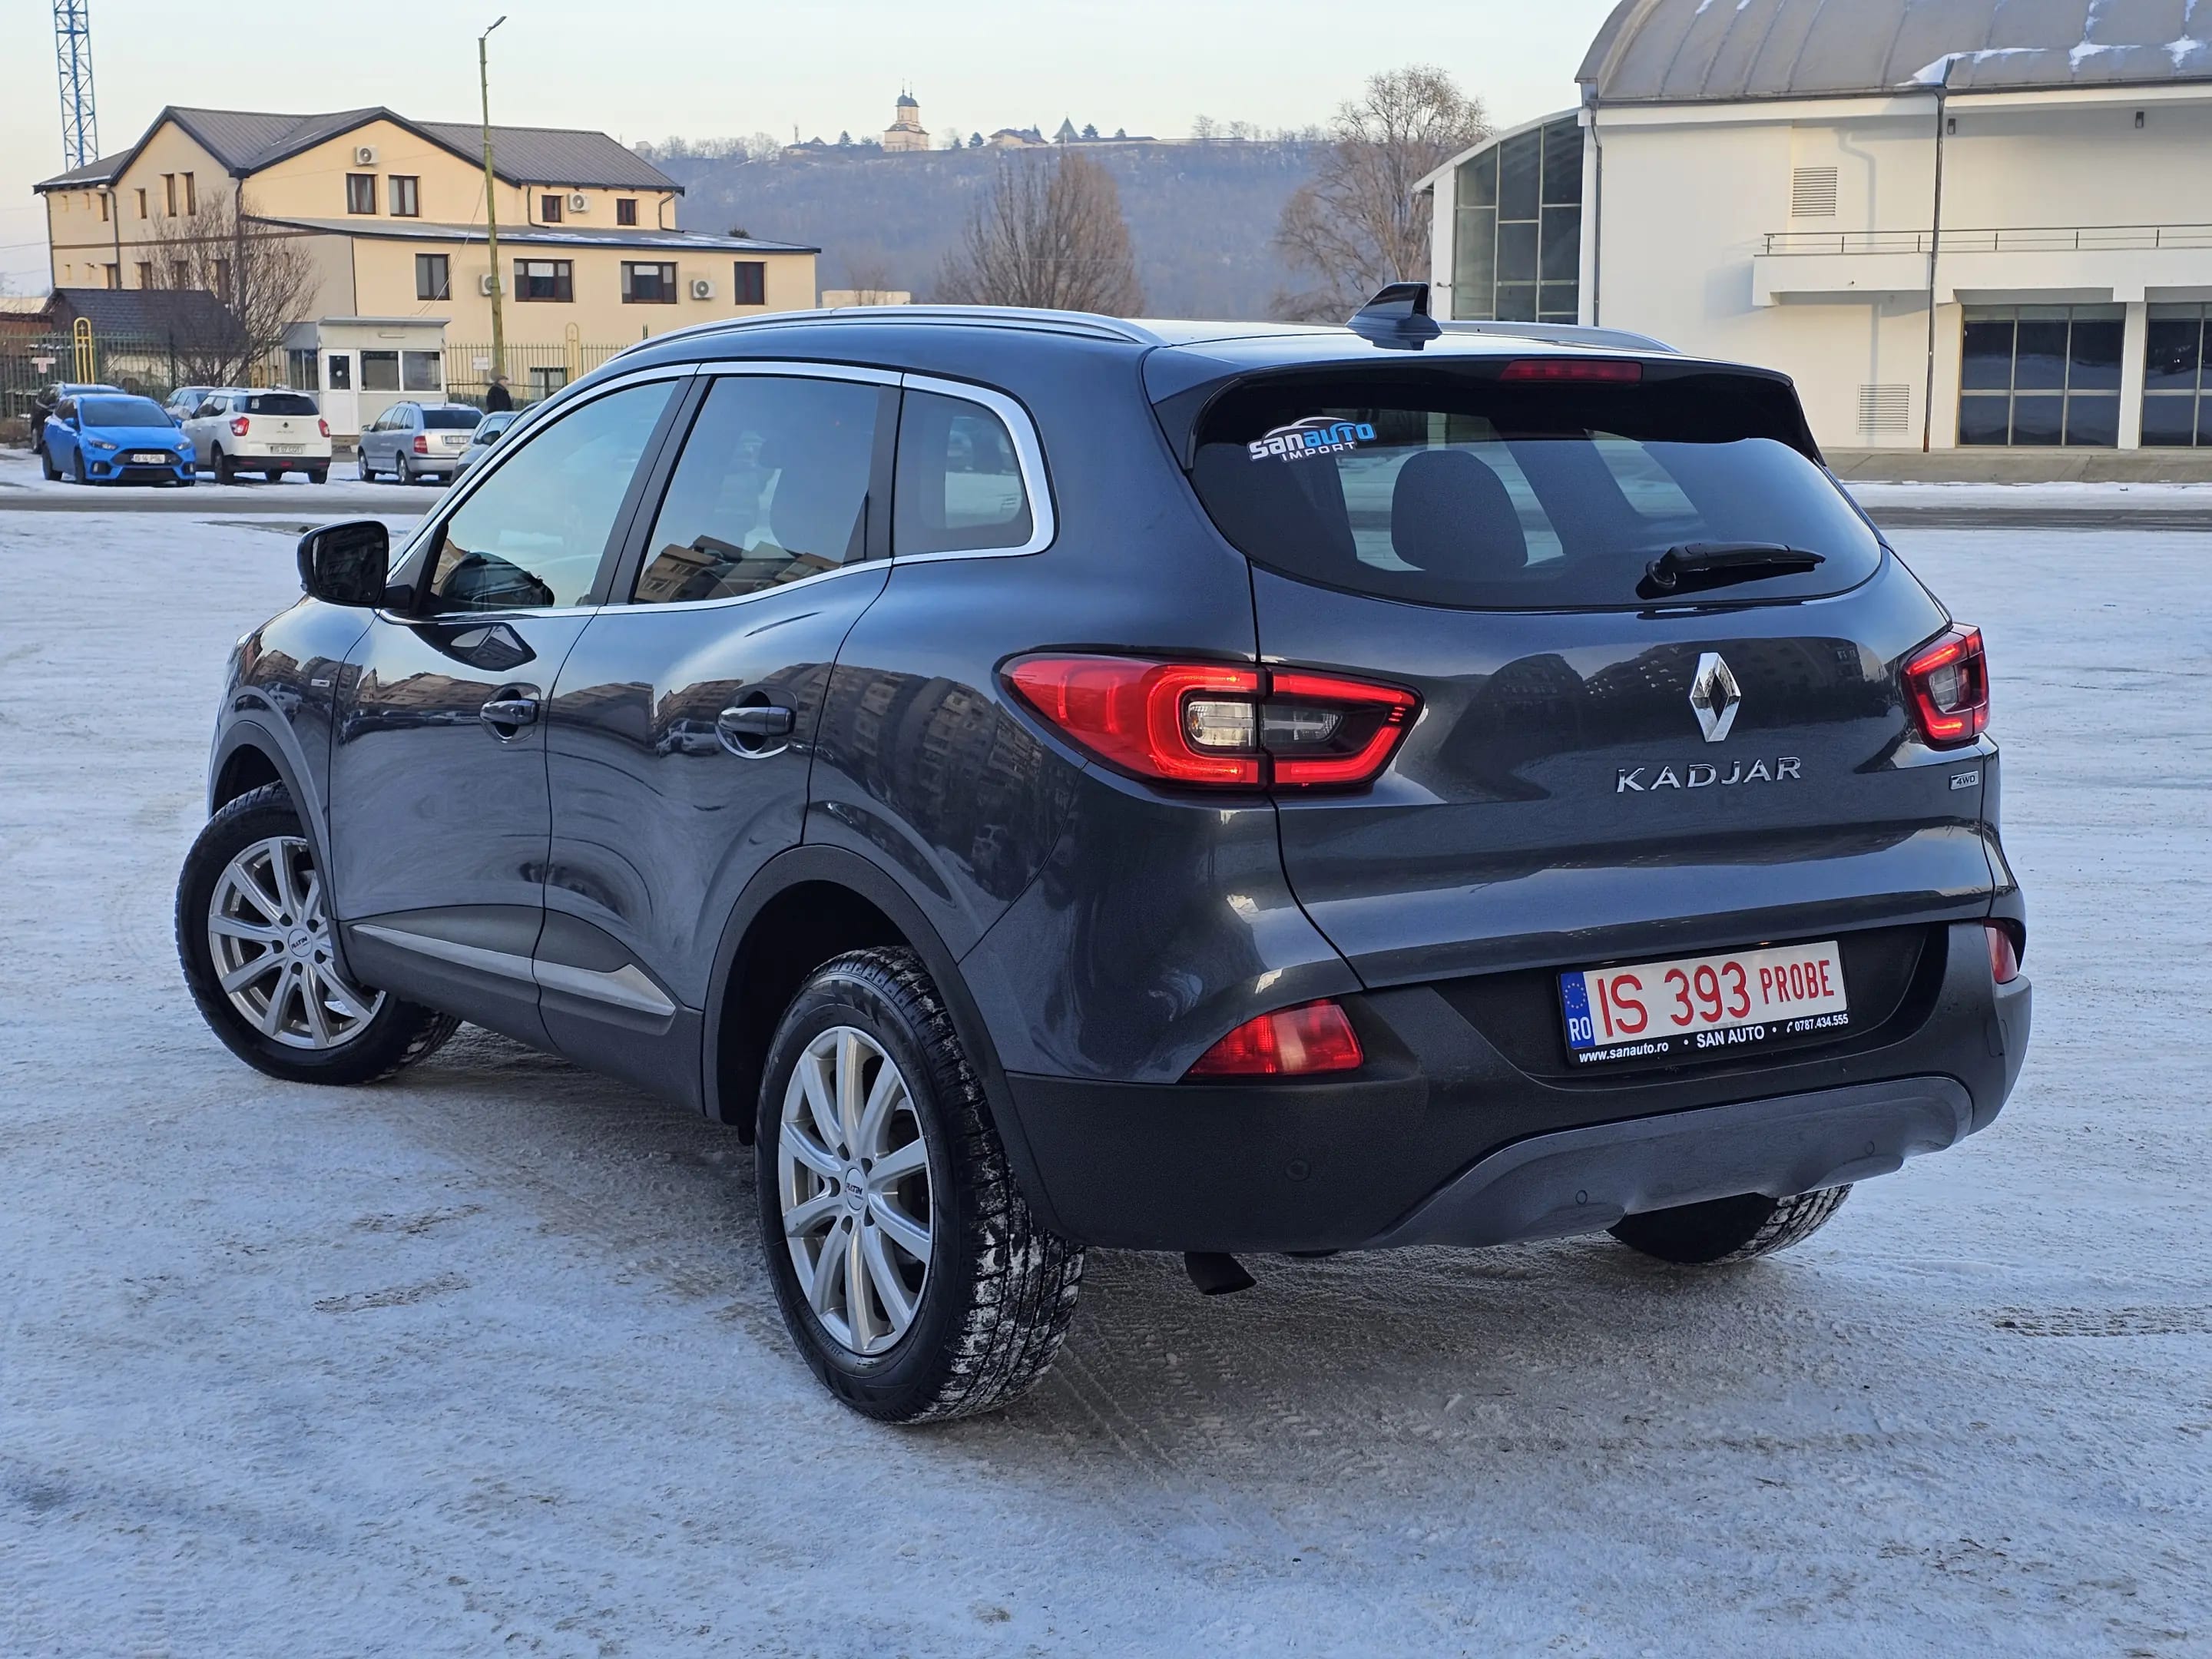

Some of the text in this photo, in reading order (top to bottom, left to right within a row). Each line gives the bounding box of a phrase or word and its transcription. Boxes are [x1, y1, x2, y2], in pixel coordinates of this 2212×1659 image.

[1282, 442, 1355, 461] IMPORT
[1616, 757, 1801, 793] KADJAR
[1956, 775, 1975, 785] 4WD
[1597, 959, 1835, 1038] IS 393 PROBE
[1568, 1015, 1591, 1042] RO
[1579, 1013, 1849, 1063] www.sanauto.ro SAN AUTO 0787.434.555
